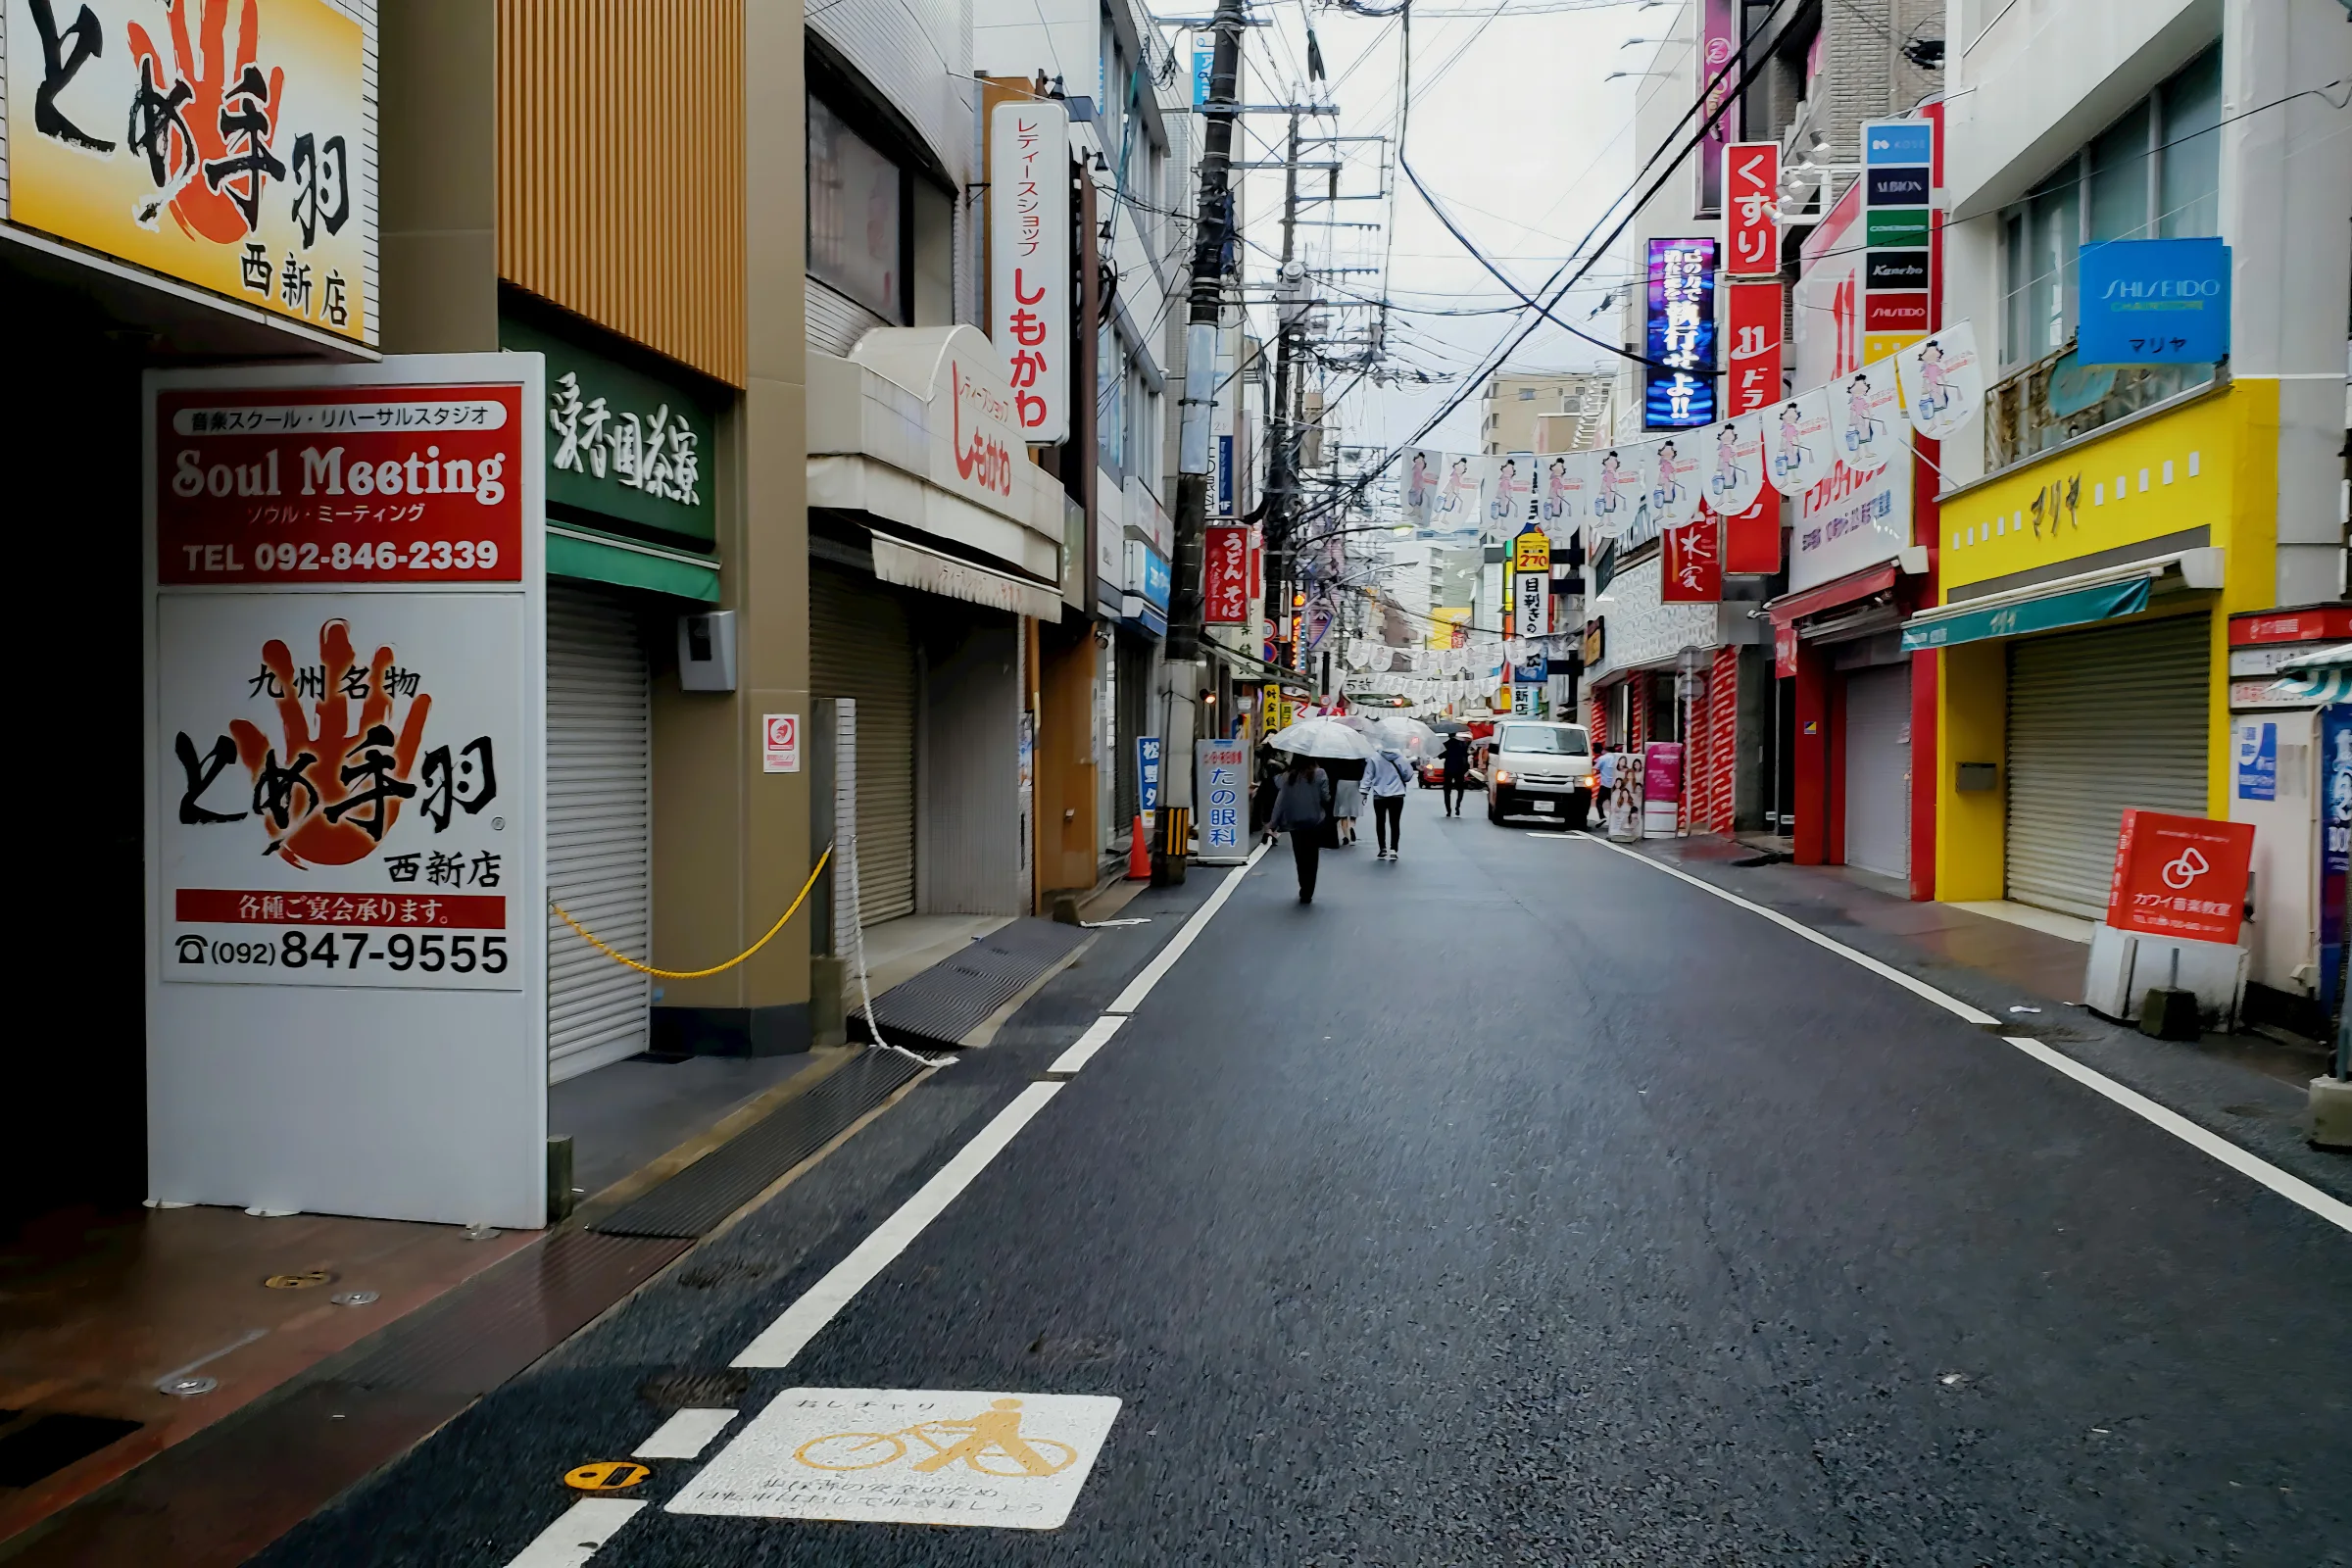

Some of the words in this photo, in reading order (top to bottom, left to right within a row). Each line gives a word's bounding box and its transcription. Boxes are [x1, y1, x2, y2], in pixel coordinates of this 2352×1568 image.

[27, 0, 350, 251] とめ手羽
[1016, 117, 1041, 257] レディースショップ
[1734, 154, 1778, 264] くすり
[1876, 180, 1924, 193] ALBION
[242, 242, 349, 327] 西新店
[2100, 277, 2221, 300] SHISEIDO
[1870, 307, 1927, 318] SHISEIDO
[1009, 267, 1048, 429] しもかわ
[2128, 336, 2188, 354] マリヤ
[952, 359, 1011, 498] しもかわ
[172, 448, 282, 498] Soul
[299, 445, 507, 506] Meeting
[247, 502, 426, 524] ソウル・ミーティング
[182, 544, 245, 571] TEL
[254, 540, 499, 571] 092-846-2339
[1222, 532, 1244, 581] うどん
[1221, 585, 1245, 618] そば
[247, 663, 422, 703] 九州名物
[174, 723, 497, 857] とめ手羽
[1210, 767, 1238, 848] たの眼科
[383, 849, 503, 889] 西新店
[238, 894, 449, 926] 各種ご宴会承ります。
[280, 929, 509, 974] 847-9555
